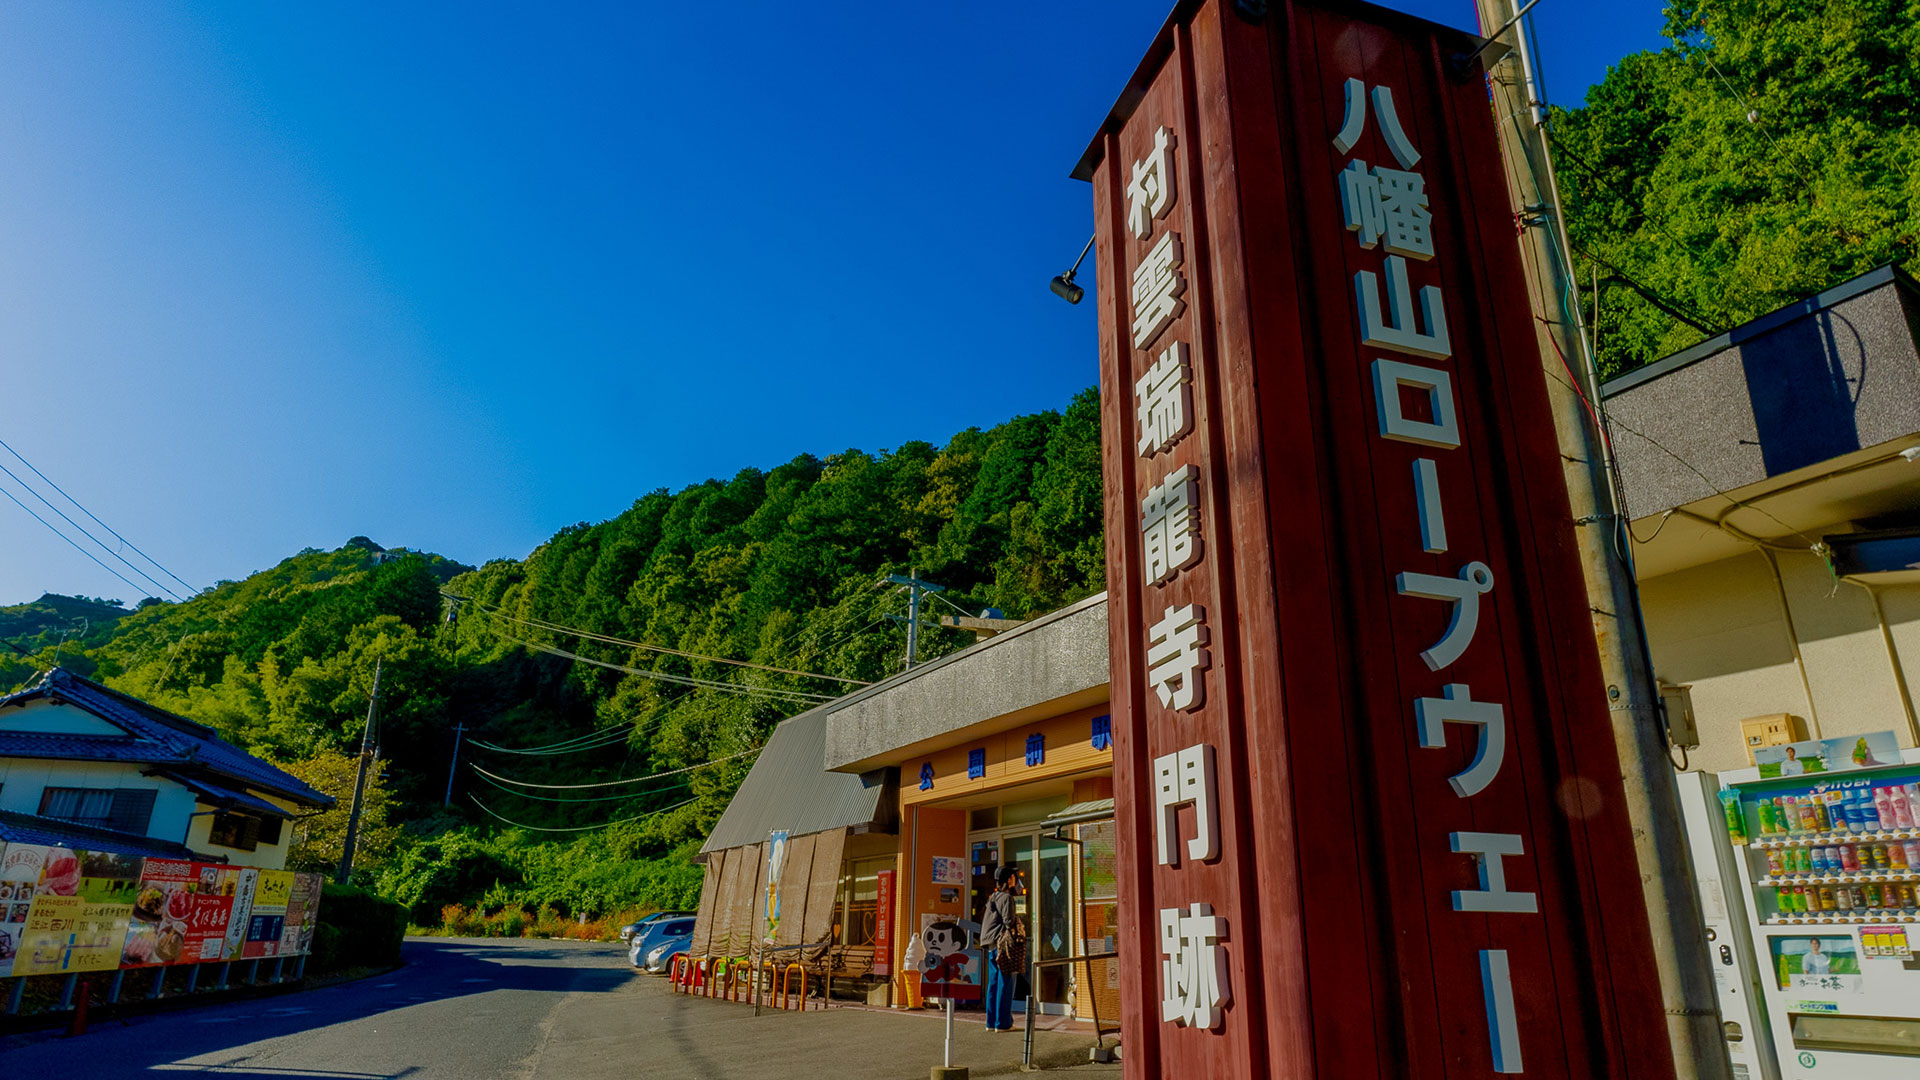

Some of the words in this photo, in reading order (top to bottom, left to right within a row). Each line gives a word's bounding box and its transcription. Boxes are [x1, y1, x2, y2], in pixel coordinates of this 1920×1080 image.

[1127, 125, 1229, 1029] 村雲瑞龍寺門跡
[1829, 779, 1853, 789] ITO
[1853, 777, 1871, 787] EN
